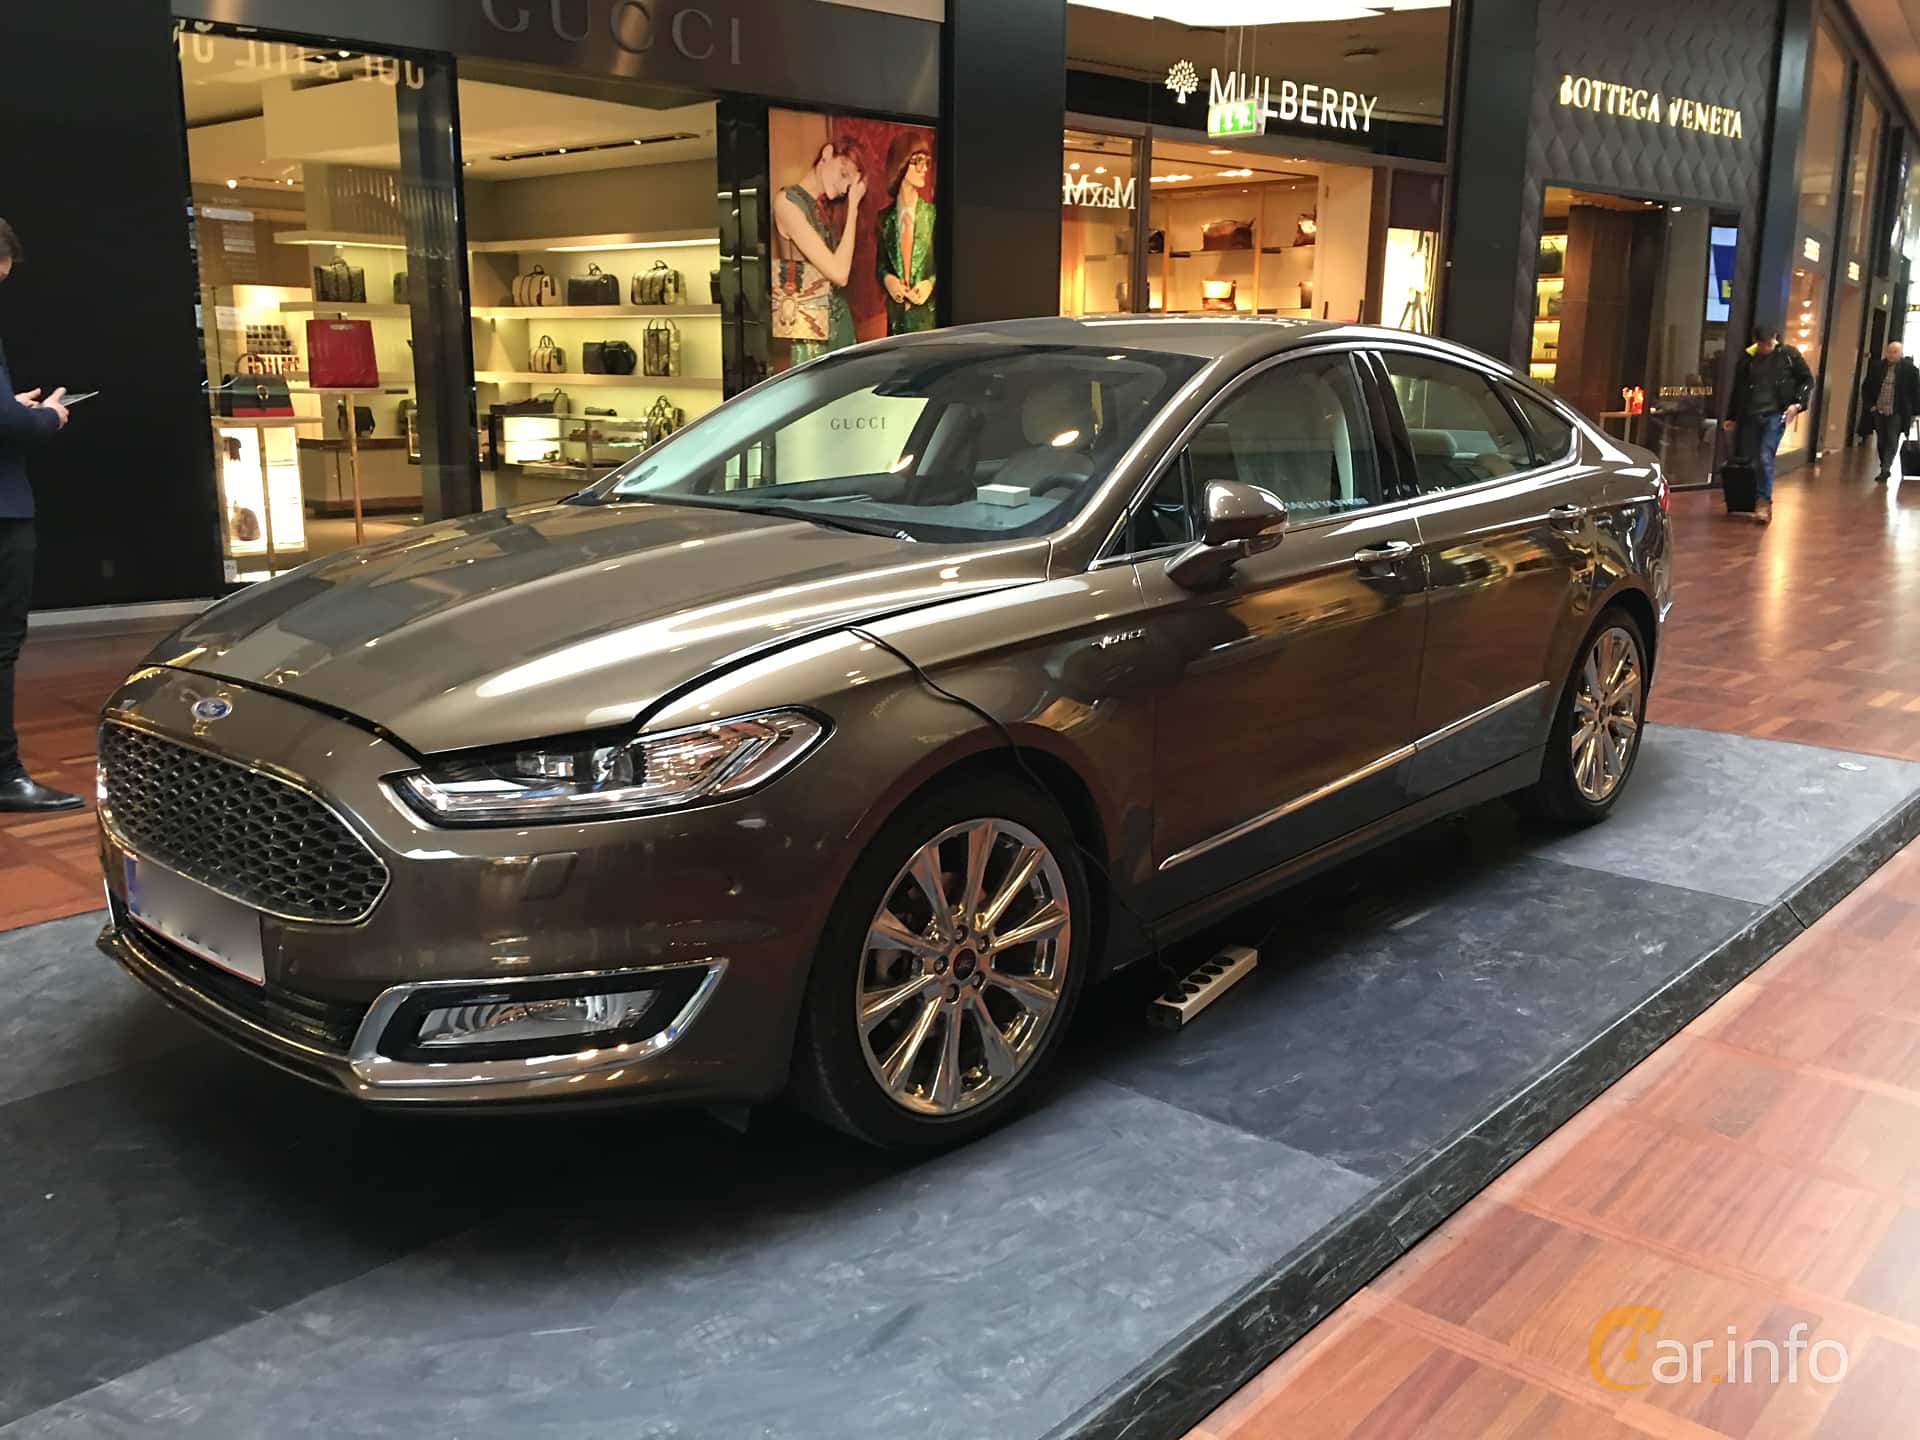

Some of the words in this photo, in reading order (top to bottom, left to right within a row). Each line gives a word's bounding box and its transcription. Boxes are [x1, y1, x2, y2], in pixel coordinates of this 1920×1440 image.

[479, 0, 742, 65] GUCCI
[1560, 74, 1661, 123] BOTTEGA
[1668, 96, 1743, 139] VENETA
